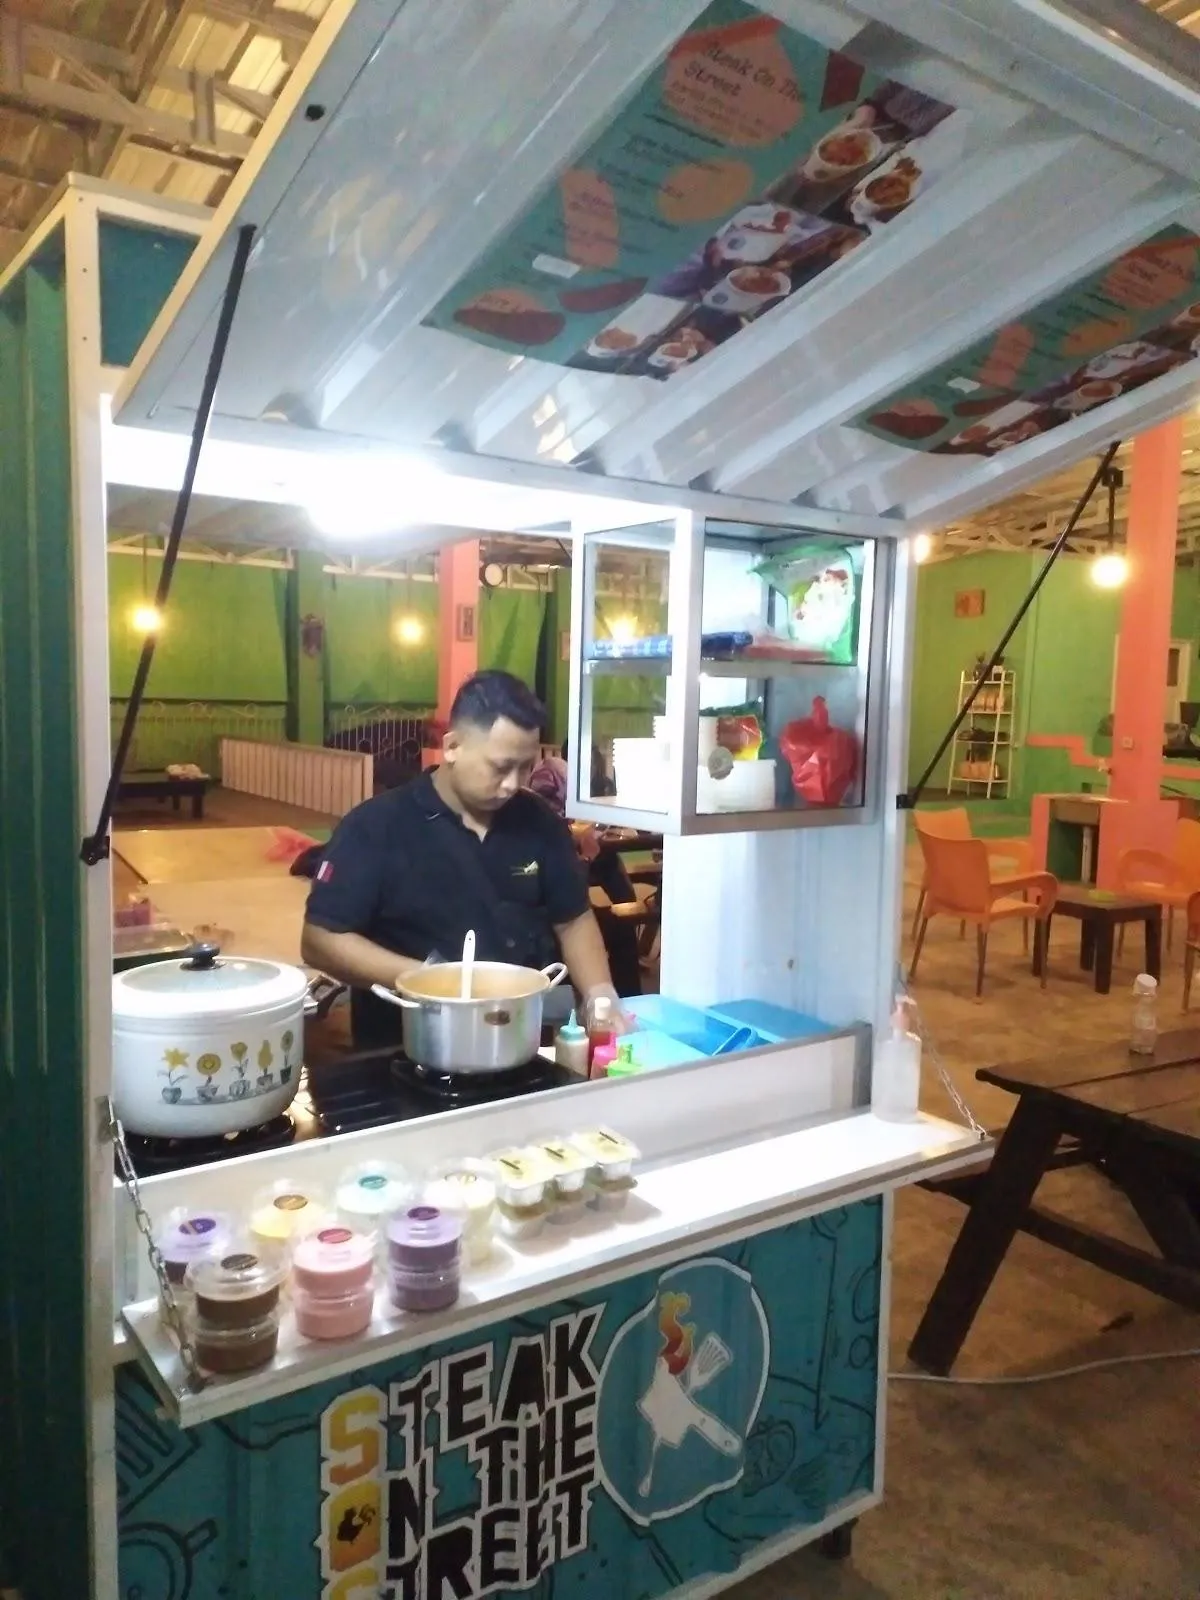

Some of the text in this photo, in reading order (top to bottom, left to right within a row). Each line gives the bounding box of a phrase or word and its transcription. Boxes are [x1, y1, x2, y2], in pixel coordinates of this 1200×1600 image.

[684, 60, 742, 97] Street
[326, 1306, 601, 1487] STEAK
[474, 1391, 598, 1507] THE
